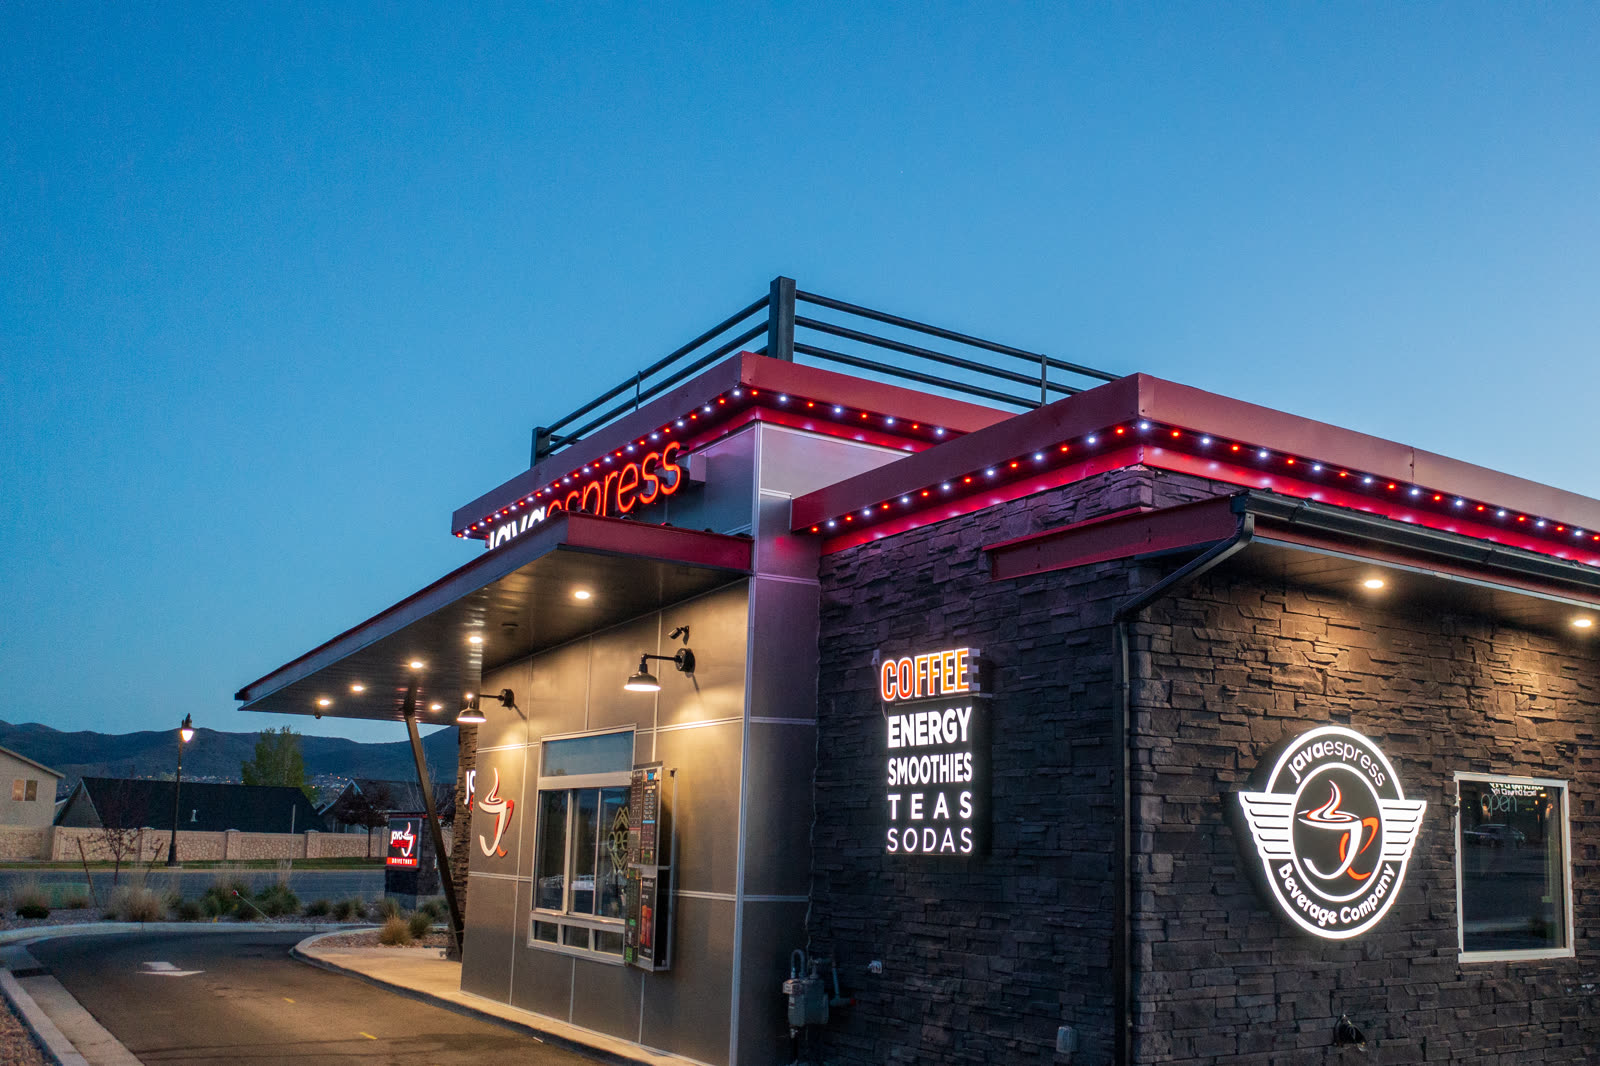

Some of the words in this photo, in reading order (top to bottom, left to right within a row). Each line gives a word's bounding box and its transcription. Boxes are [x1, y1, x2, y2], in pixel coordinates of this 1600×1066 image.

[881, 648, 969, 701] COFFEE
[887, 706, 972, 748] ENERGY
[887, 752, 972, 786] SMOOTHIES
[607, 831, 629, 852] OPE
[887, 827, 972, 853] SODAS
